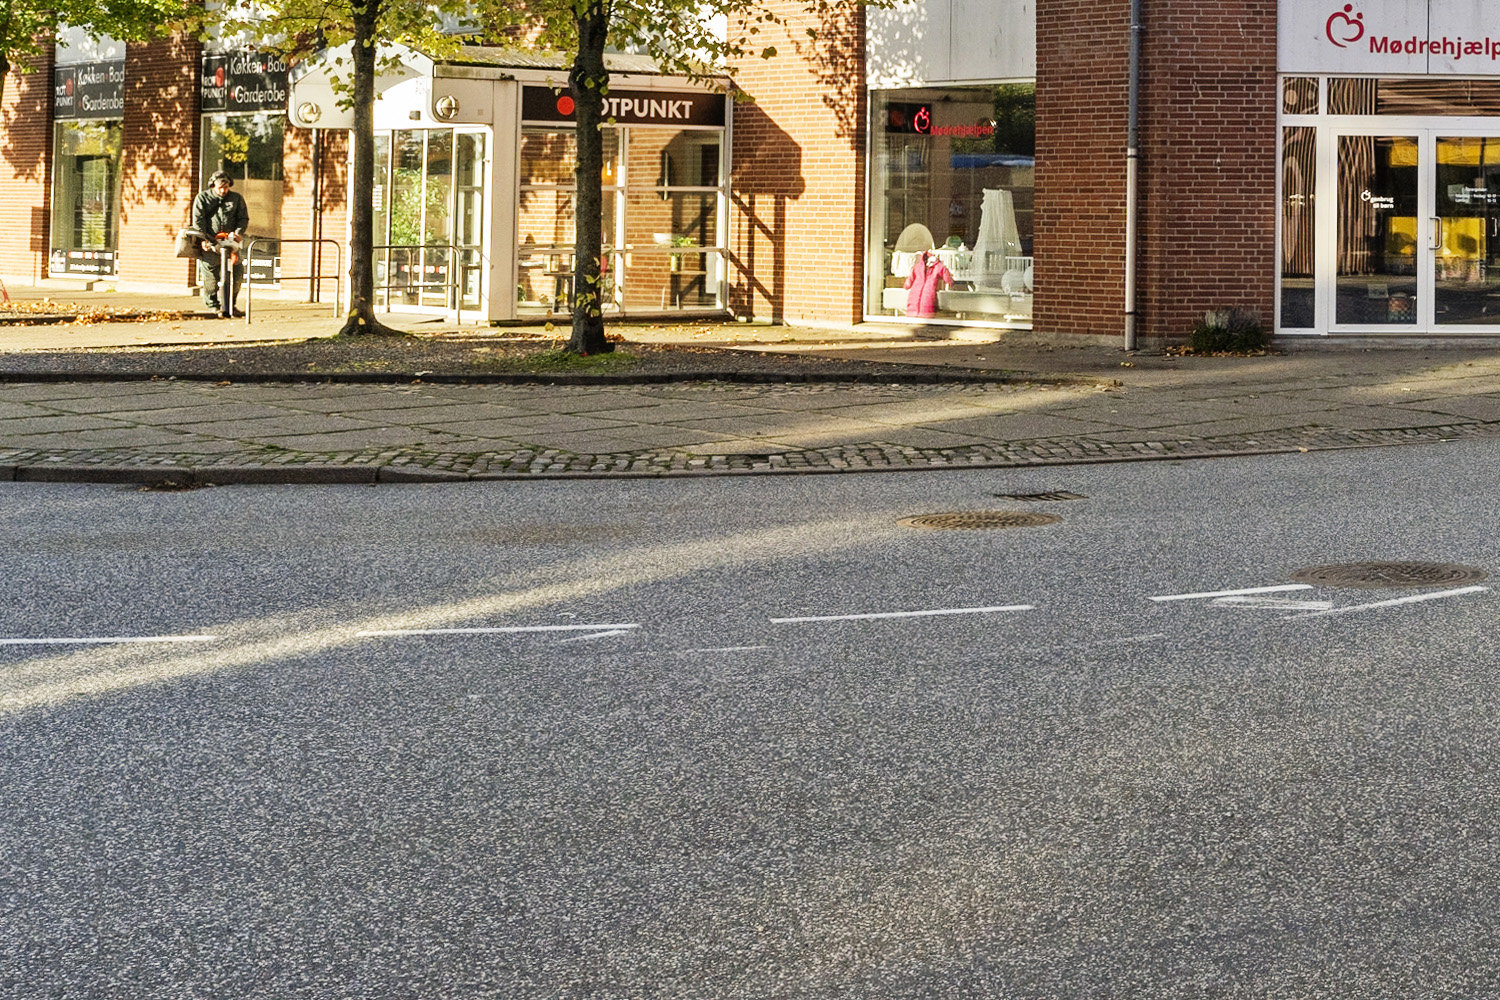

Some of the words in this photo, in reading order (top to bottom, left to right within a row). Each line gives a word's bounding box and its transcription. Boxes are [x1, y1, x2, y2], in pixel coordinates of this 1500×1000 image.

[77, 66, 105, 86] Køkken
[108, 64, 125, 83] Bad
[230, 54, 263, 75] Køkken
[267, 54, 286, 73] Bad
[56, 96, 73, 107] PUNKT
[82, 91, 124, 112] Garderobe
[203, 87, 225, 99] PUNKT
[234, 82, 286, 104] Garderobe
[600, 97, 694, 119] TPUNKT
